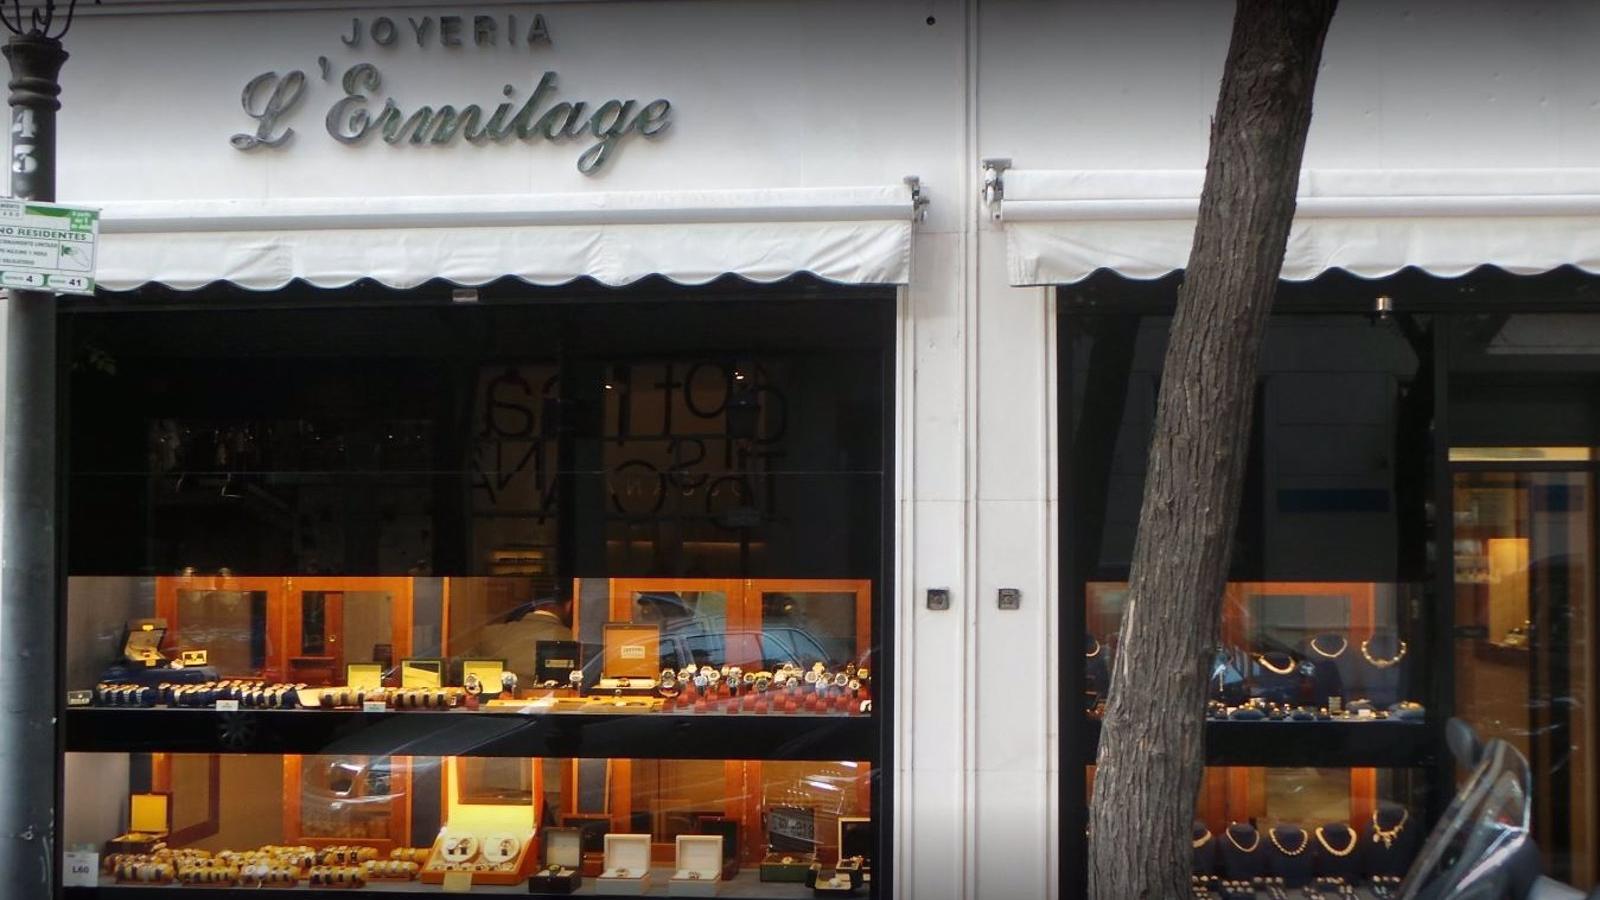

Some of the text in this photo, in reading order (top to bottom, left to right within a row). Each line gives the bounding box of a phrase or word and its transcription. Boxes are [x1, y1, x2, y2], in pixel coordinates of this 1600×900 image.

[340, 14, 553, 48] JOYERIA
[230, 55, 674, 176] L'Ermitage
[18, 227, 87, 241] RESIDENTES
[69, 279, 81, 287] 41
